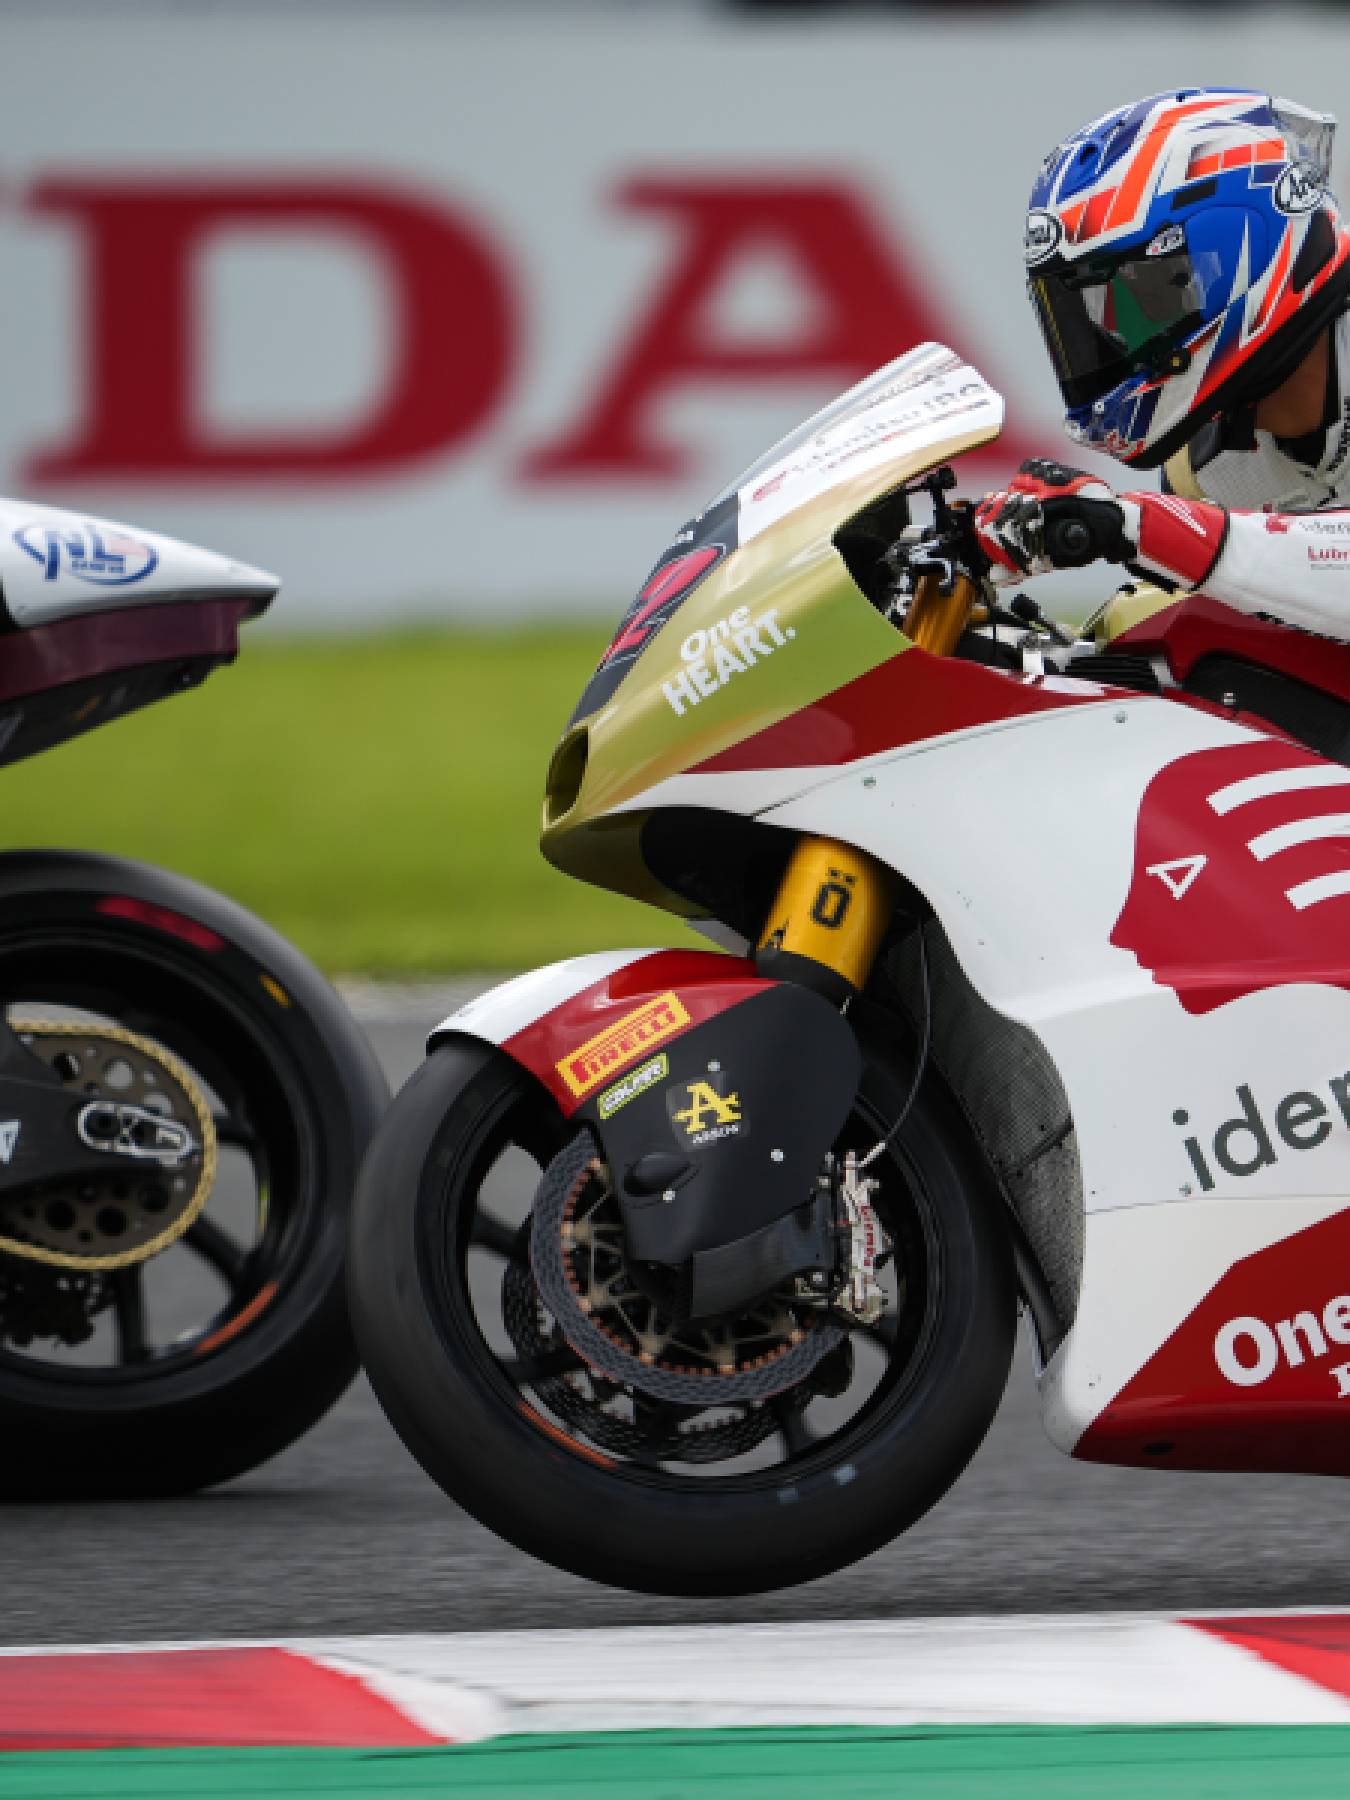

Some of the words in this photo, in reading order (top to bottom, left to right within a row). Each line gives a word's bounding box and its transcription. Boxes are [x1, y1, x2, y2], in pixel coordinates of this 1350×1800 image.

[0, 165, 1015, 488] DA
[661, 607, 797, 717] HEART.
[680, 605, 750, 662] One
[568, 1000, 678, 1084] PIRELLI
